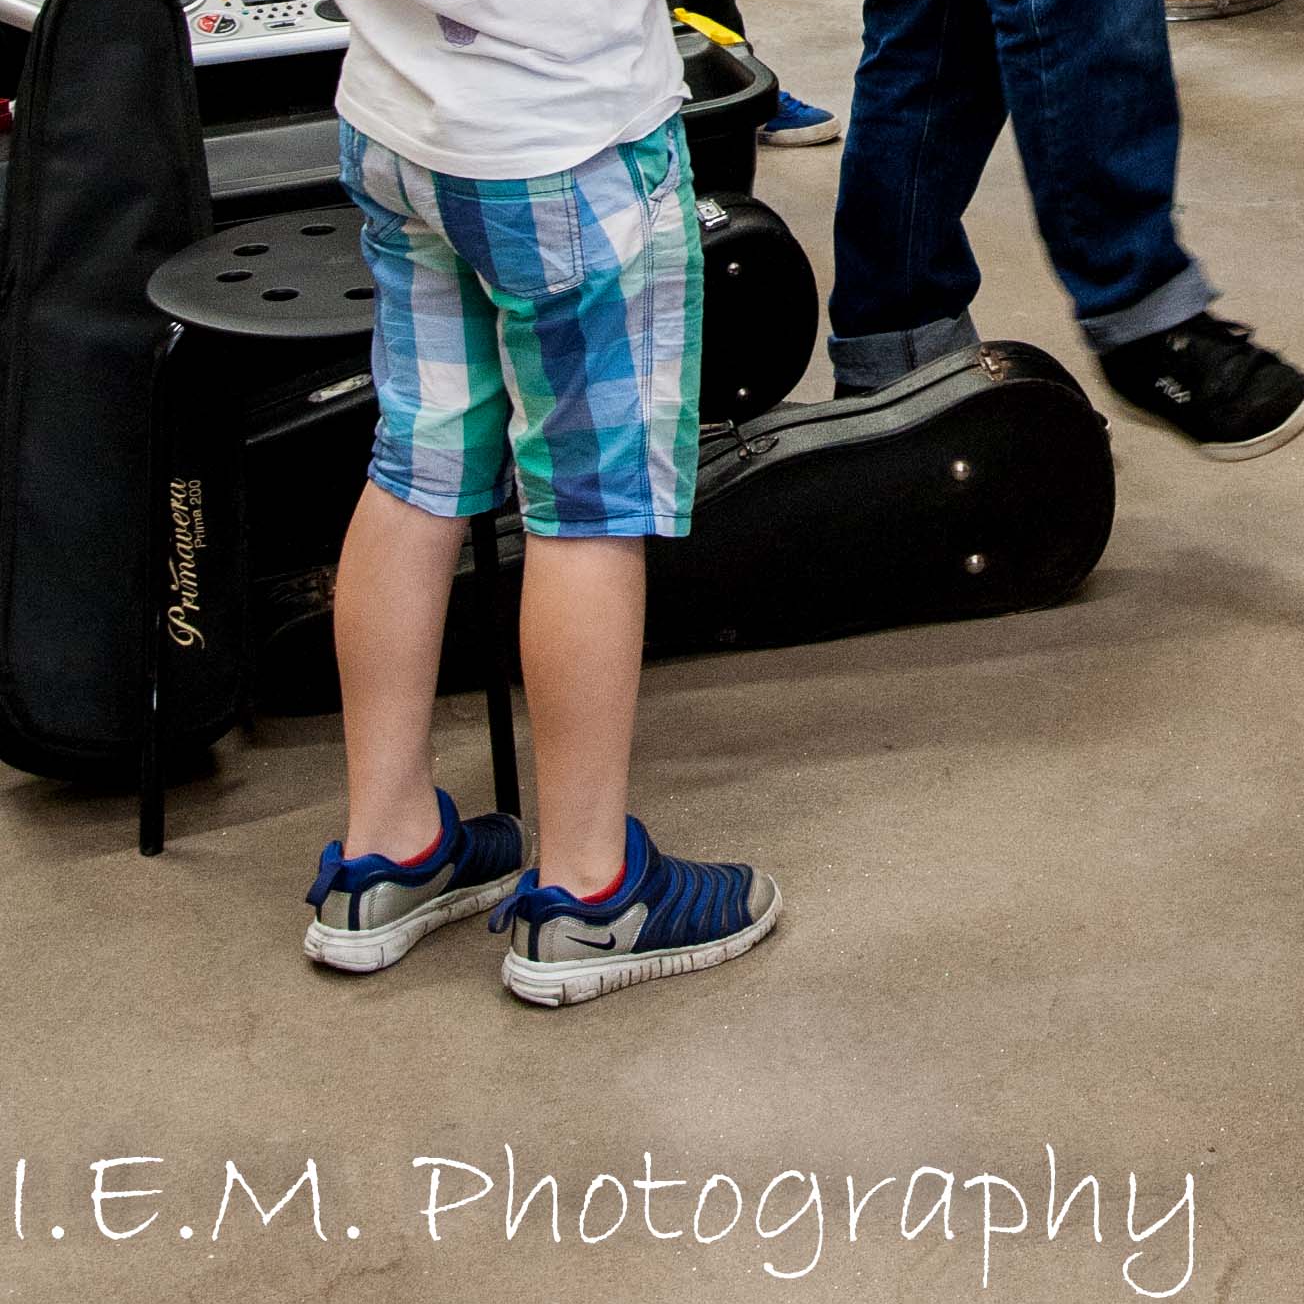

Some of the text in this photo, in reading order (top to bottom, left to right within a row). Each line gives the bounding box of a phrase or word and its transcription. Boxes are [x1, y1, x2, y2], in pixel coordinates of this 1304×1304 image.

[167, 477, 206, 650] Primavera
[188, 478, 208, 549] Prima 200
